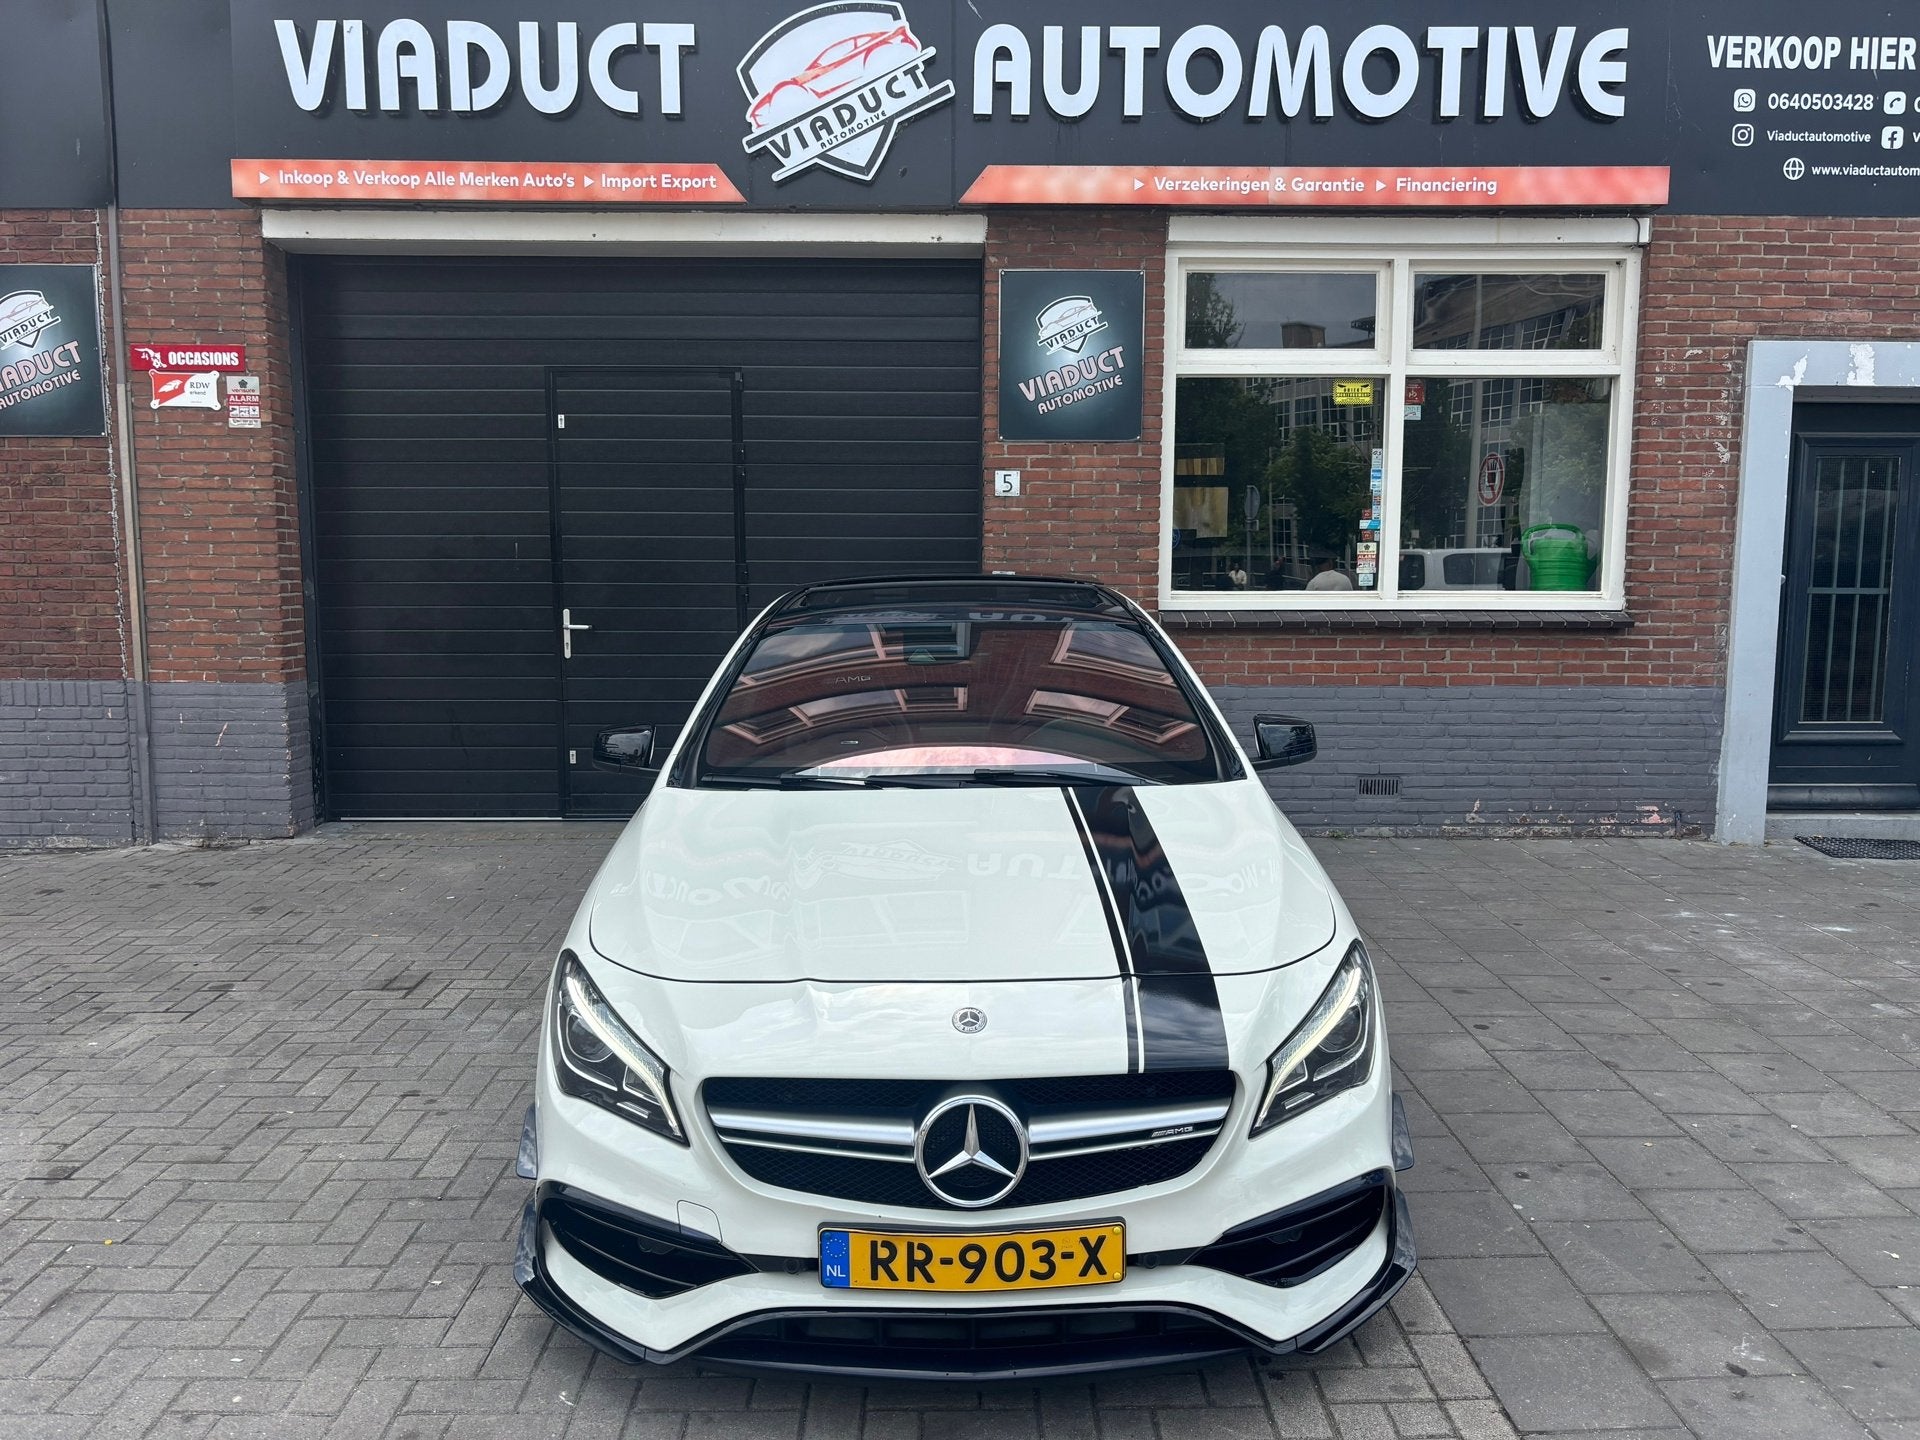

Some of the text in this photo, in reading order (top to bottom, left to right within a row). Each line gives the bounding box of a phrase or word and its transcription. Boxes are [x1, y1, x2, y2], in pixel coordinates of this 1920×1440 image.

[274, 18, 696, 115] VIADUCT
[1707, 35, 1917, 70] VERKOOP HIER
[973, 24, 1629, 119] AUTOMOTIVE
[768, 63, 924, 159] VIADUCT
[1767, 93, 1874, 111] 0640503428
[820, 109, 887, 149] AUTOMOTIVE
[1766, 130, 1872, 143] Viaductautomotive
[279, 170, 575, 189] Inkoop & Verkoop Alle Merken Auto's
[601, 173, 717, 192] Import Export
[1154, 176, 1365, 195] Verzekeringen & Garantie
[1396, 176, 1497, 195] Financiering
[0, 311, 50, 343] VIADUCT
[1046, 316, 1098, 348] VIADUCT
[0, 340, 81, 391] ADUCT
[168, 351, 239, 366] OCCASIONS
[1018, 346, 1126, 402] VIADUCT
[189, 381, 210, 390] RDW
[1037, 374, 1123, 415] AUTOMOTIVE
[1002, 474, 1013, 493] 5
[826, 1235, 1108, 1284] NL RR-903-X
